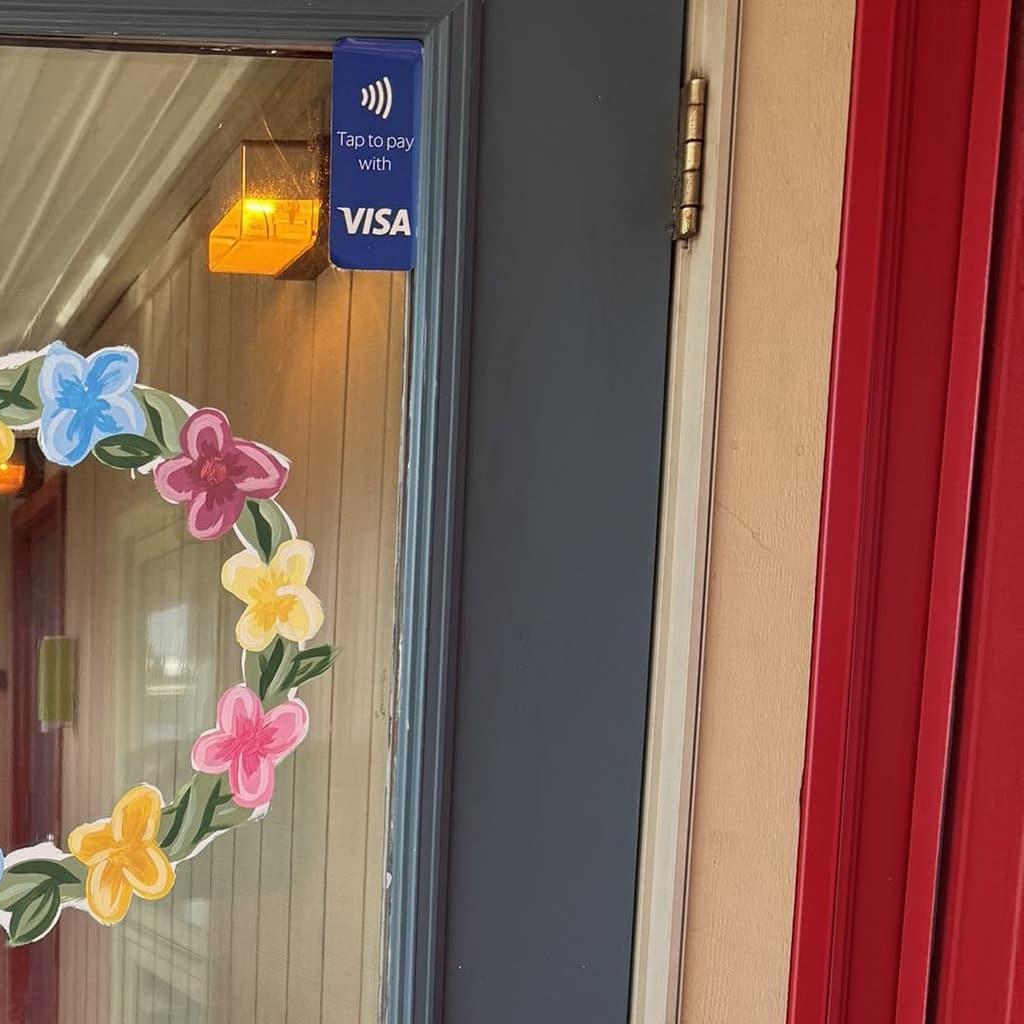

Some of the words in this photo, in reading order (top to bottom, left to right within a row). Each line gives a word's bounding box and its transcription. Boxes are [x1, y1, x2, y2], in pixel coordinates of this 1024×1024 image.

[336, 131, 365, 150] Tap
[368, 134, 384, 149] to
[386, 135, 415, 151] pay
[358, 156, 392, 171] with
[336, 206, 412, 236] VISA
